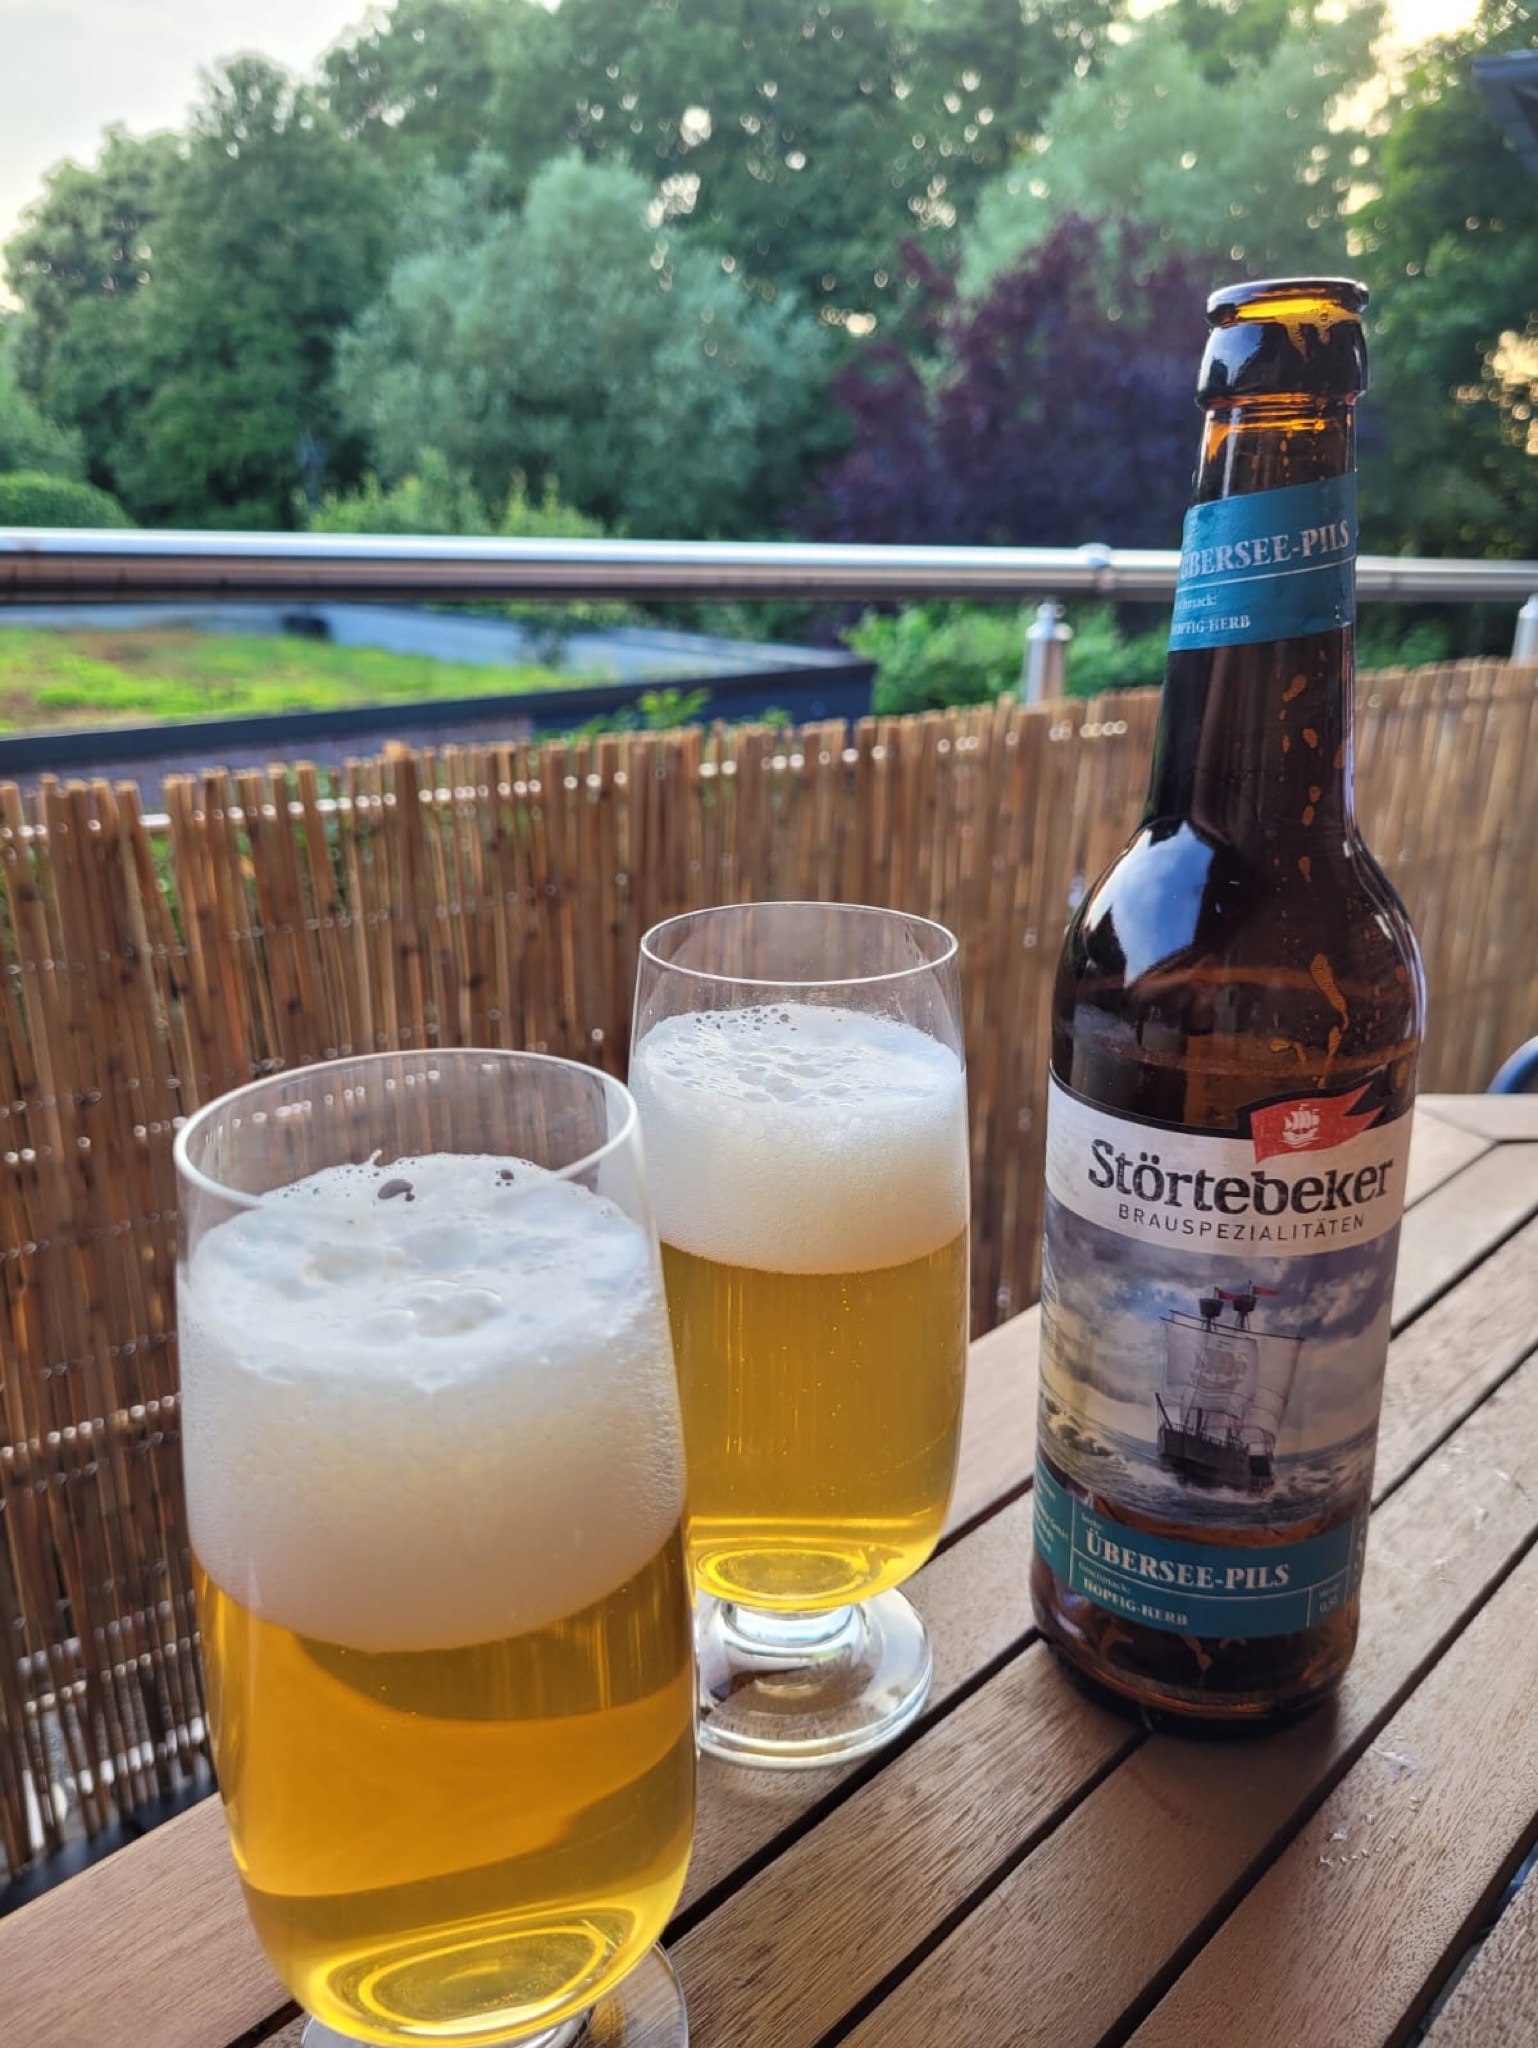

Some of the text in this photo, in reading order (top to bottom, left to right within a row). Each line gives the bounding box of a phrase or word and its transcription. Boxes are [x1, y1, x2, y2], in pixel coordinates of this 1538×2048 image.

[1088, 1138, 1395, 1217] Störtebeker
[1118, 1203, 1365, 1242] BRAUSPEZIALITÄTEN
[1086, 1527, 1290, 1590] ÜBERSEE-PILS
[1083, 1577, 1189, 1626] HOPFIG-HERB
